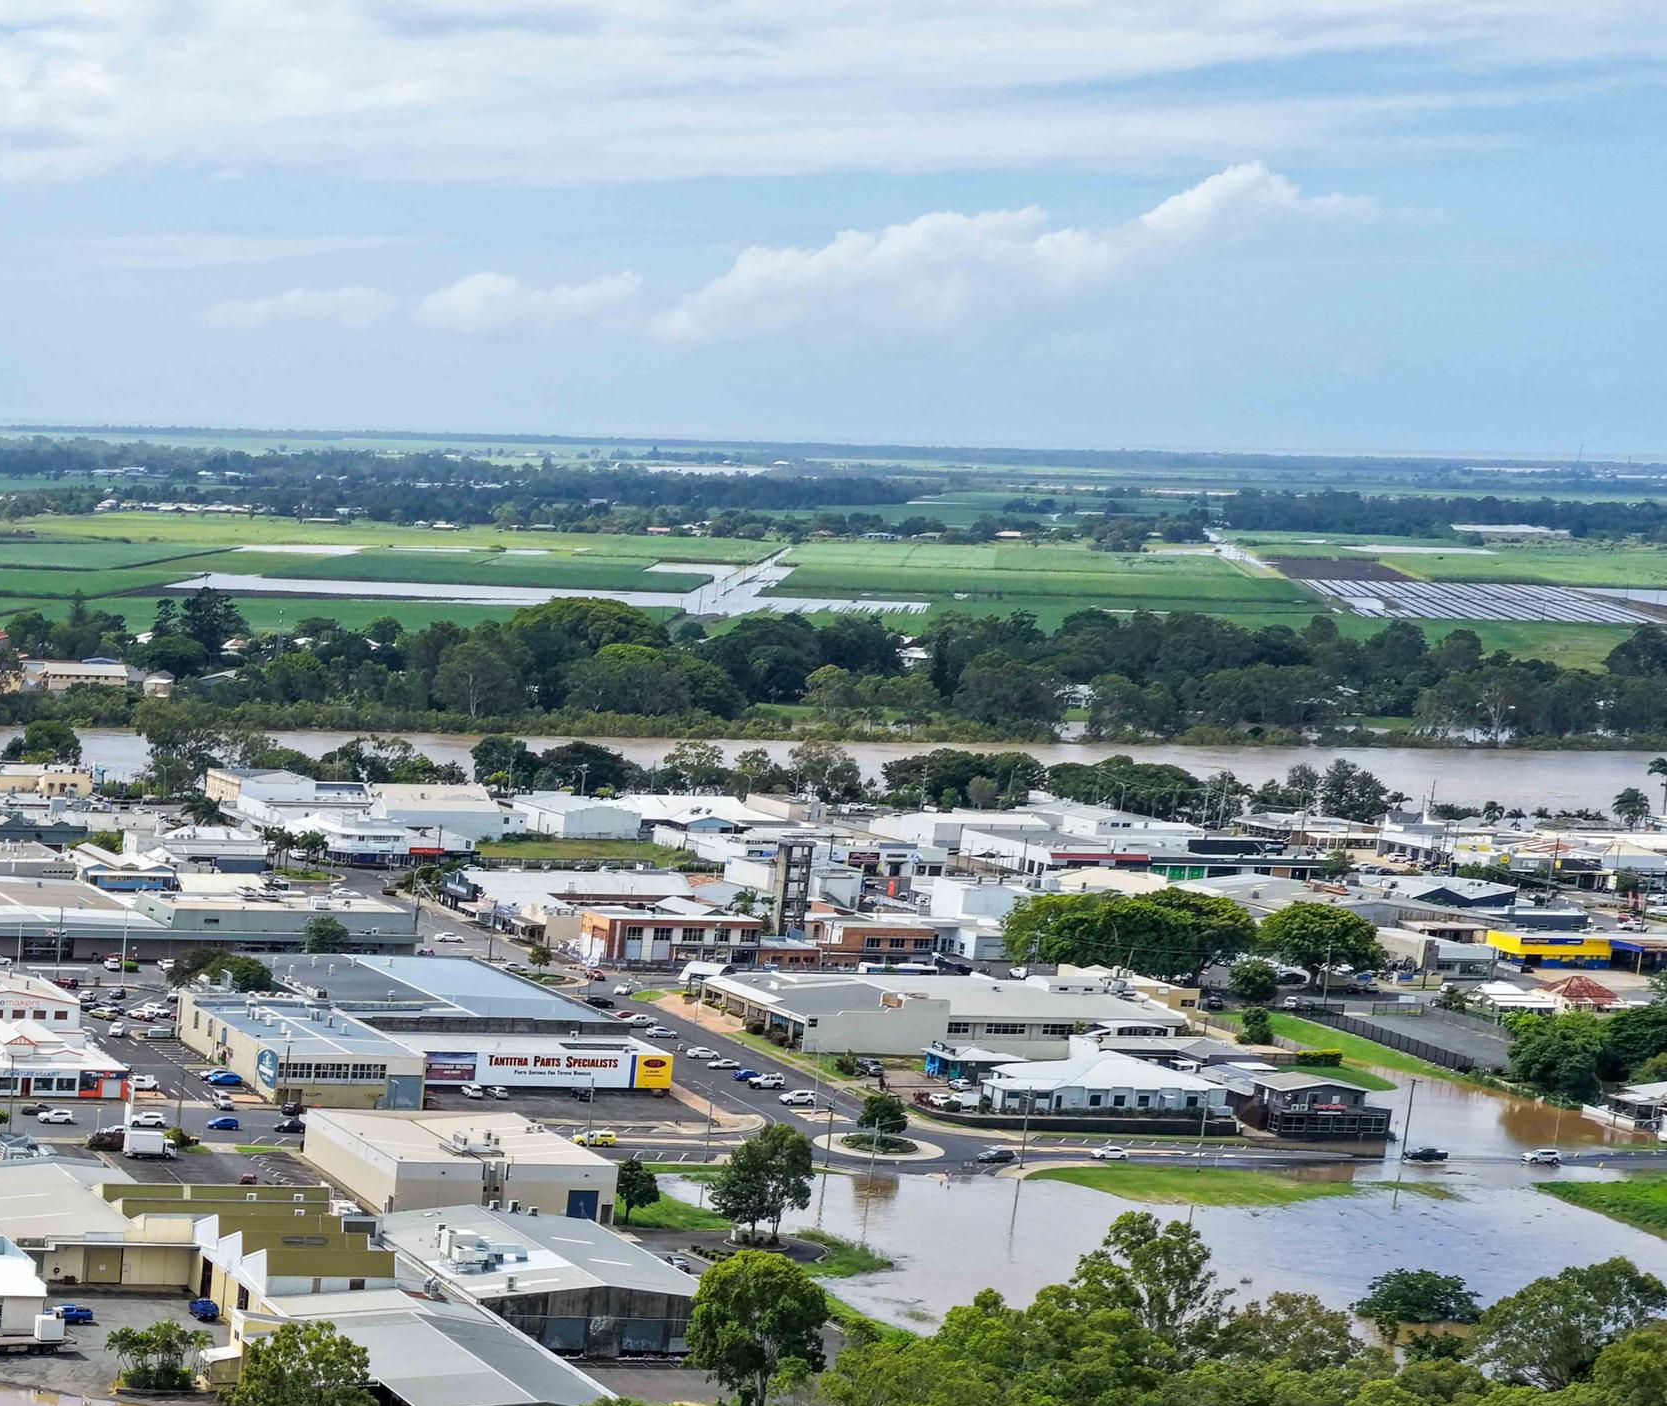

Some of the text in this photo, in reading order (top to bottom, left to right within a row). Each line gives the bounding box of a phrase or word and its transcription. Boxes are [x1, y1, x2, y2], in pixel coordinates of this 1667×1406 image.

[488, 1055, 528, 1067] TANTITHA
[533, 1056, 561, 1067] PARTS
[566, 1056, 618, 1069] SPECIALISTS
